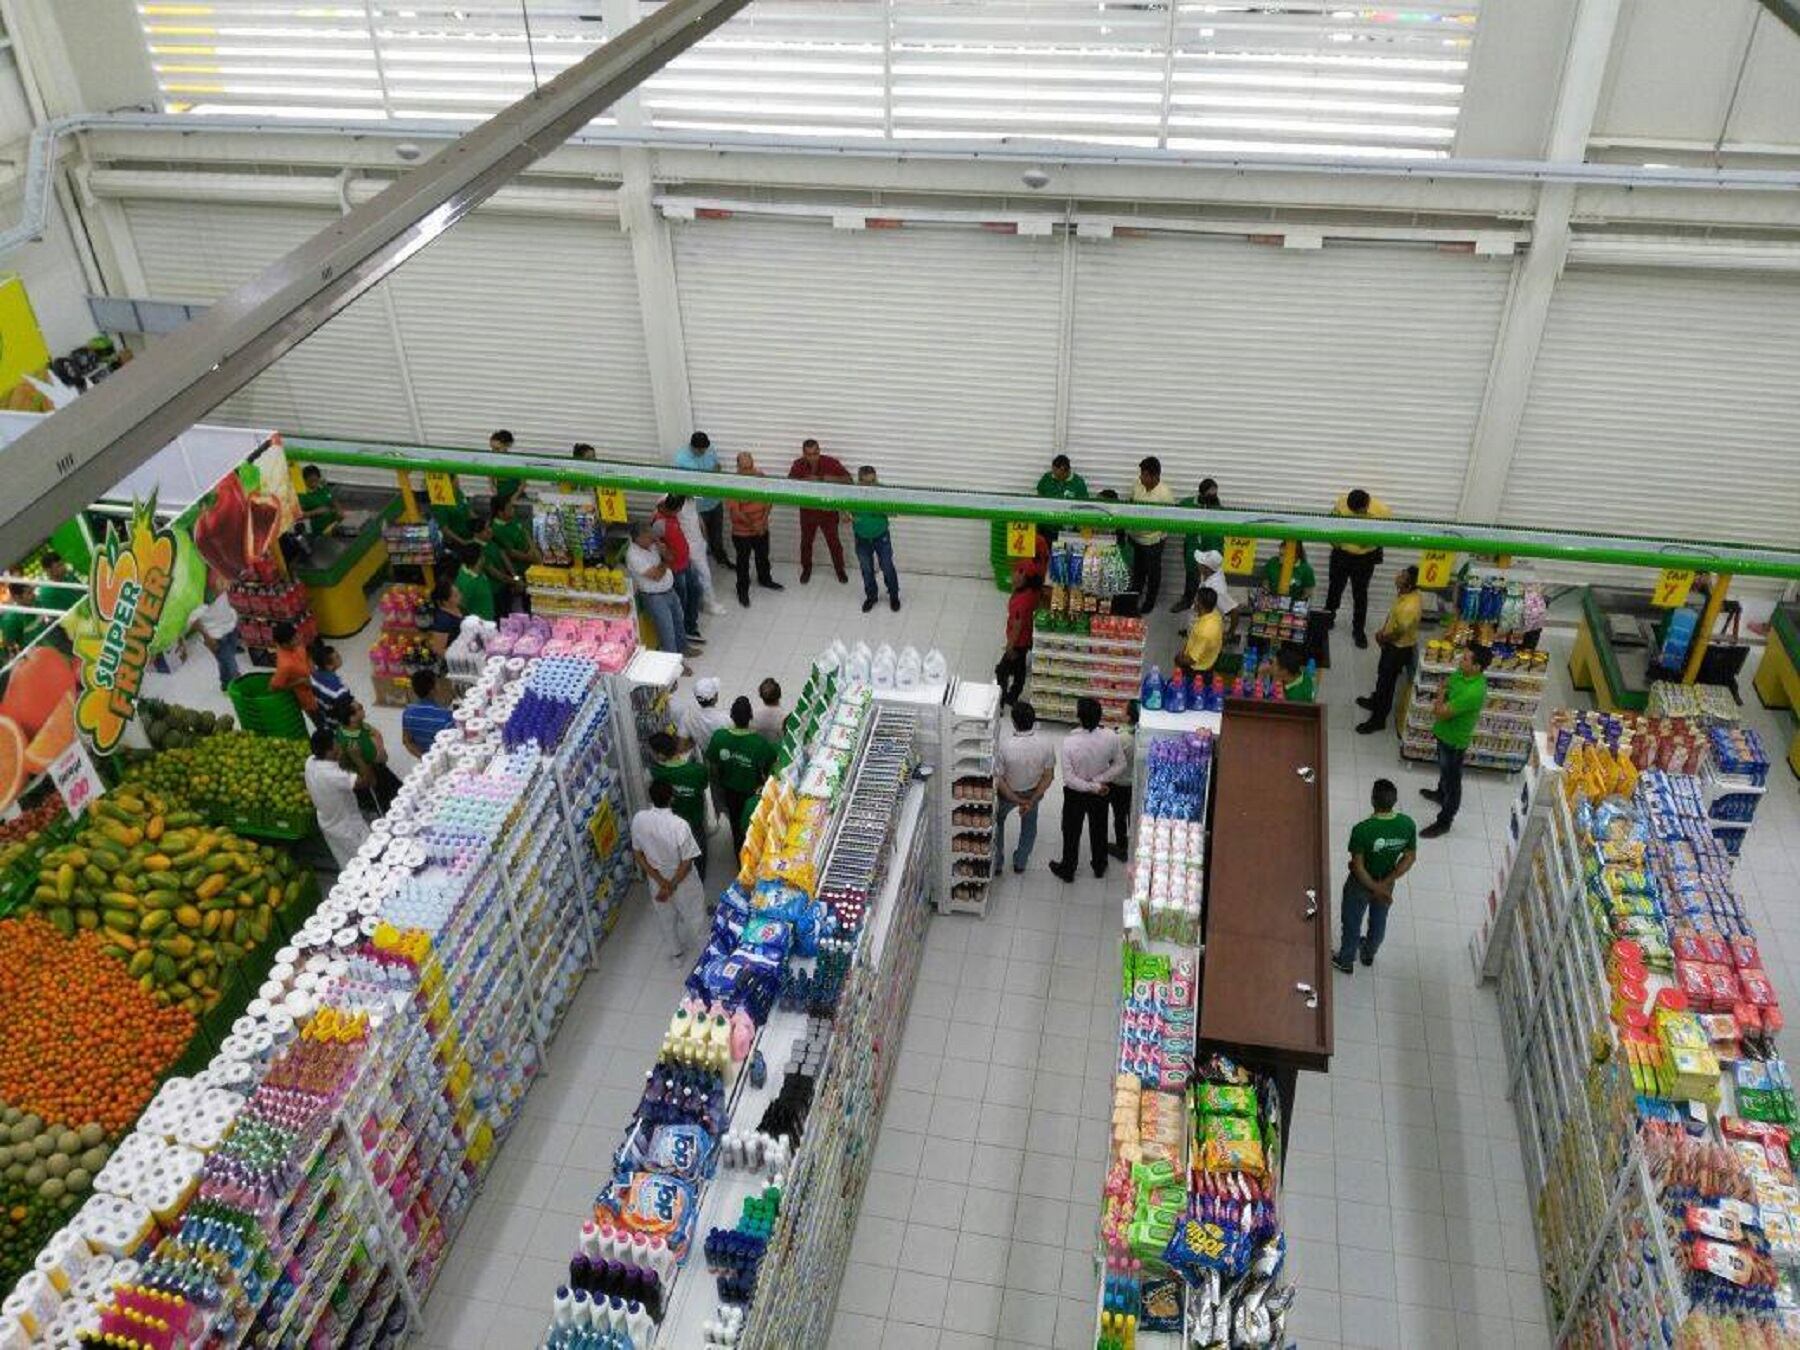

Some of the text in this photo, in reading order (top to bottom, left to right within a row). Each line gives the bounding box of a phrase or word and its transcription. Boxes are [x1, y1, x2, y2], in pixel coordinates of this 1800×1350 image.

[1013, 534, 1026, 553] 4
[1231, 549, 1244, 569] 5
[1425, 562, 1439, 583] 6
[1662, 582, 1679, 603] 7
[95, 579, 141, 691] SUPER
[109, 567, 173, 721] FRUVER
